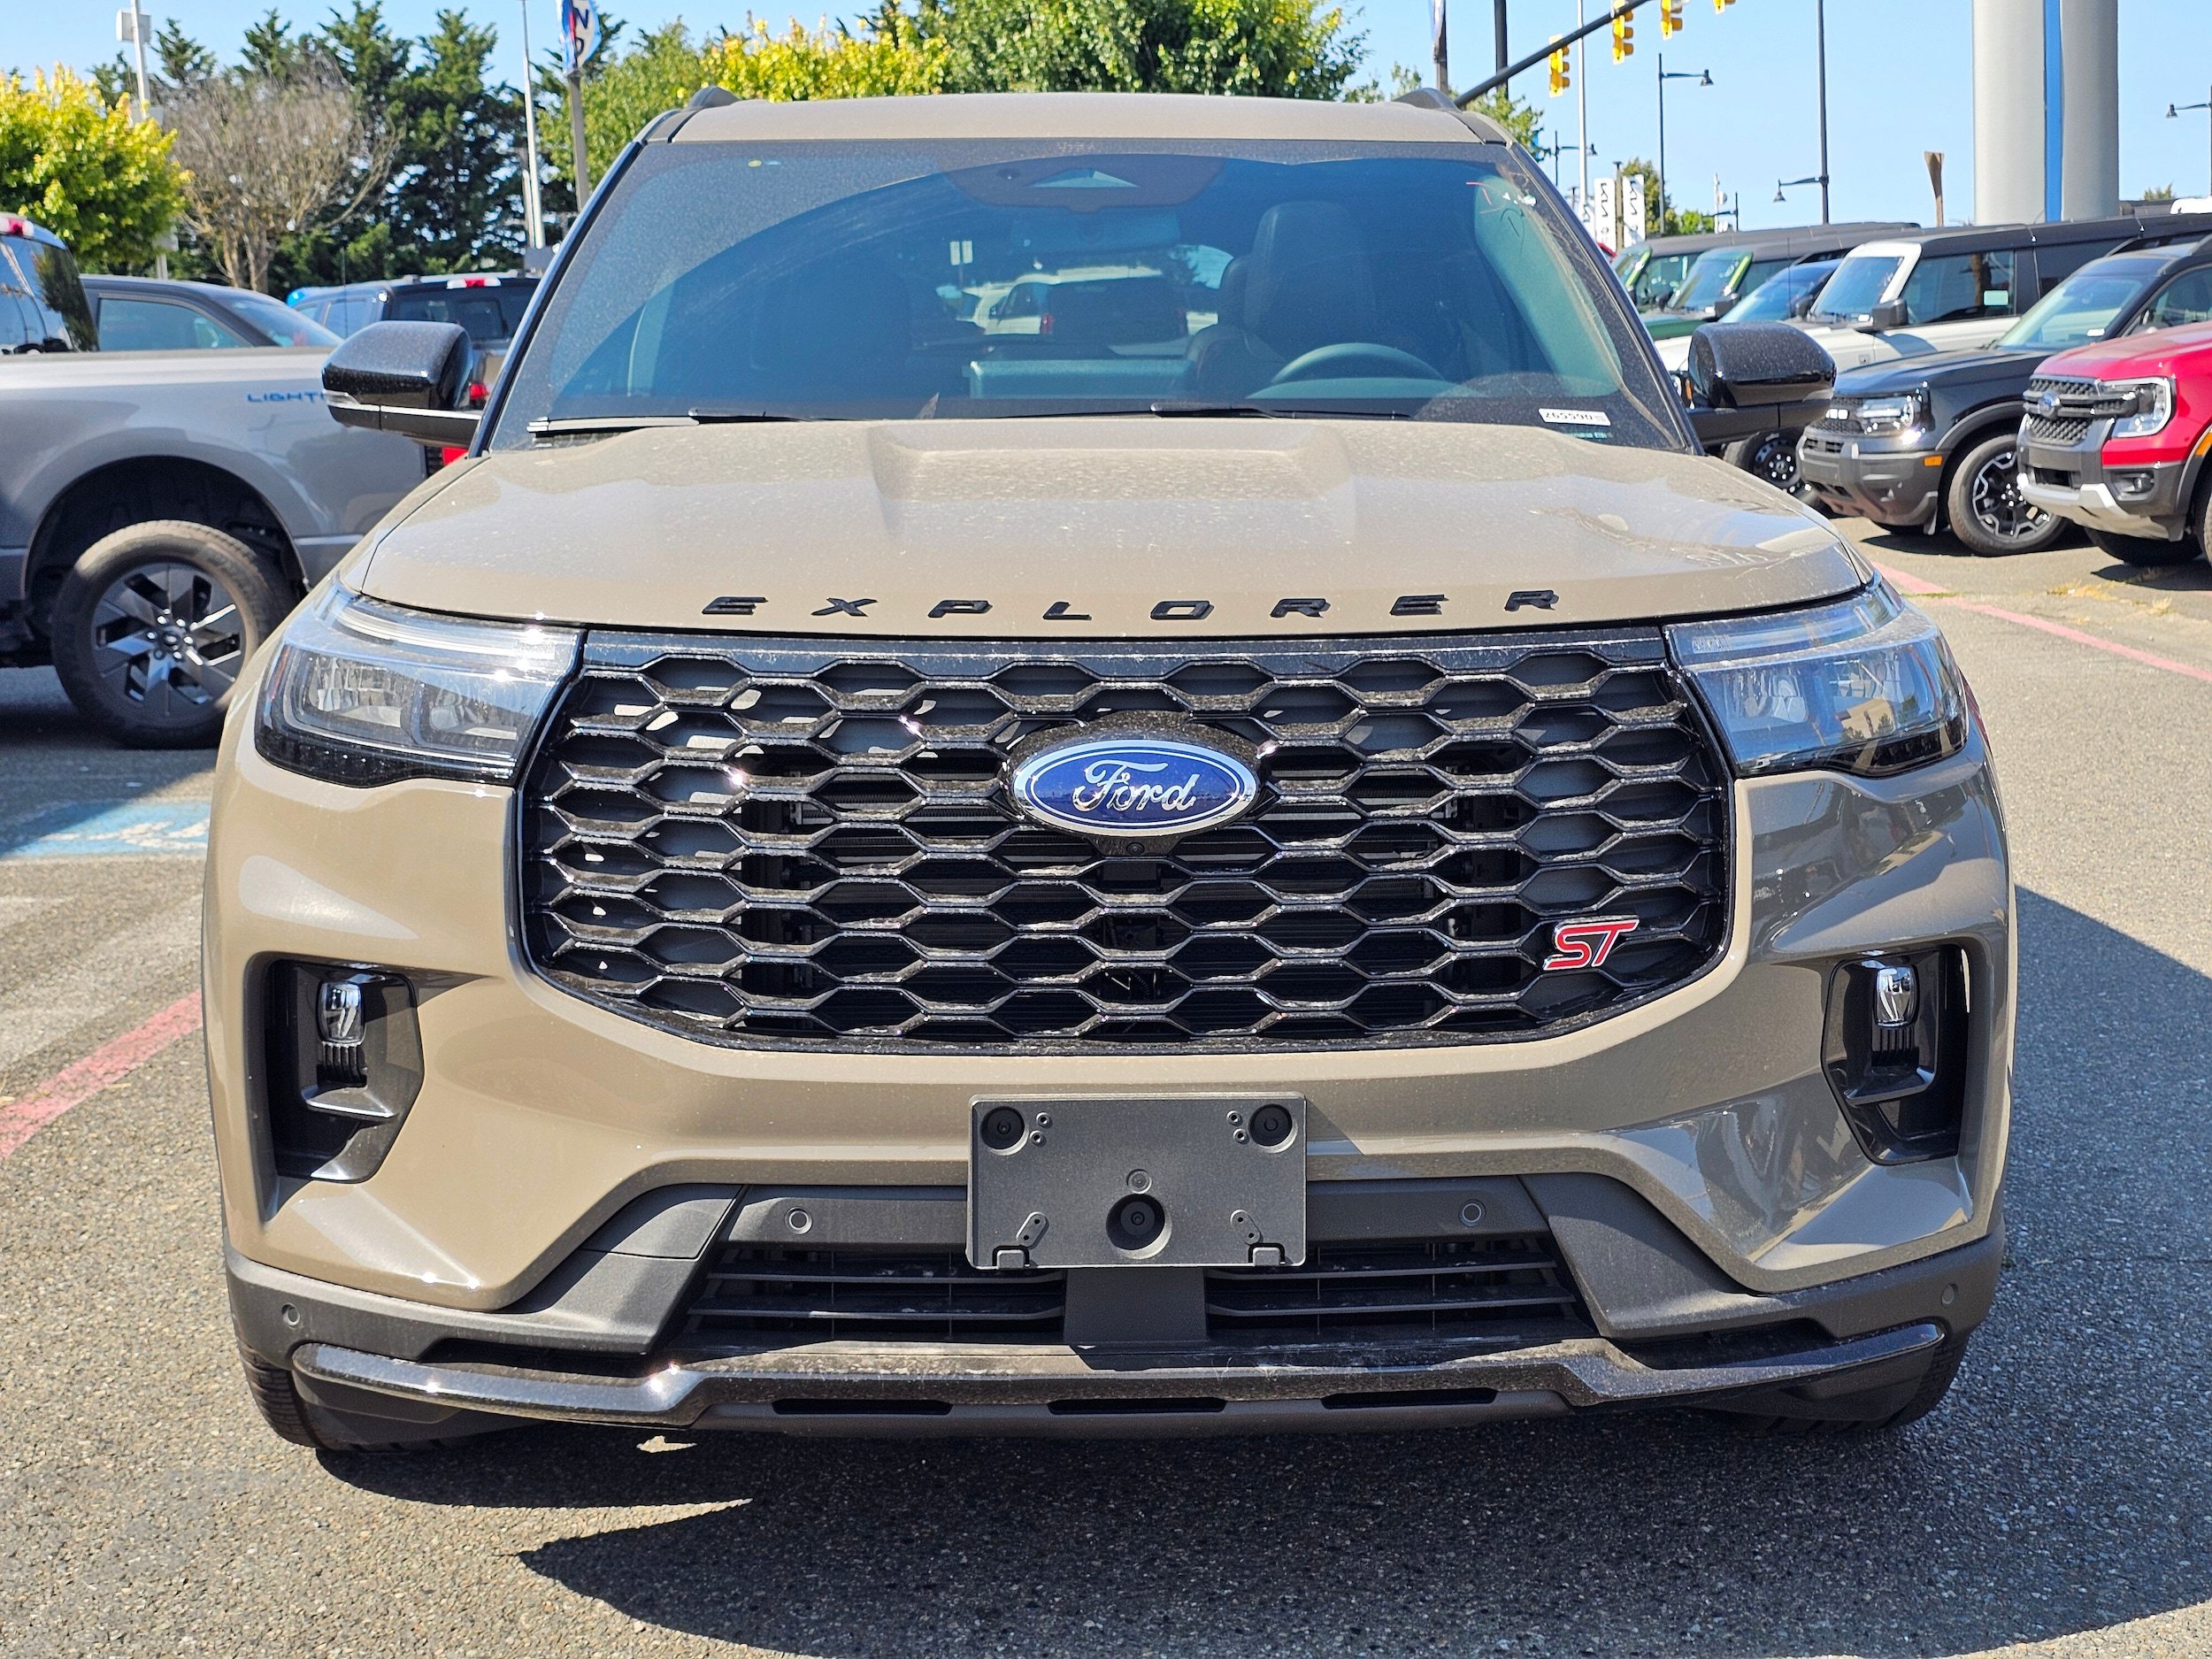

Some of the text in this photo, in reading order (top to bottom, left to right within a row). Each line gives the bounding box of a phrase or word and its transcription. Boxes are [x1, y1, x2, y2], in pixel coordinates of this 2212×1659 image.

[702, 590, 1560, 621] EXPLORER
[1071, 758, 1201, 812] Ford
[1542, 918, 1640, 971] ST
